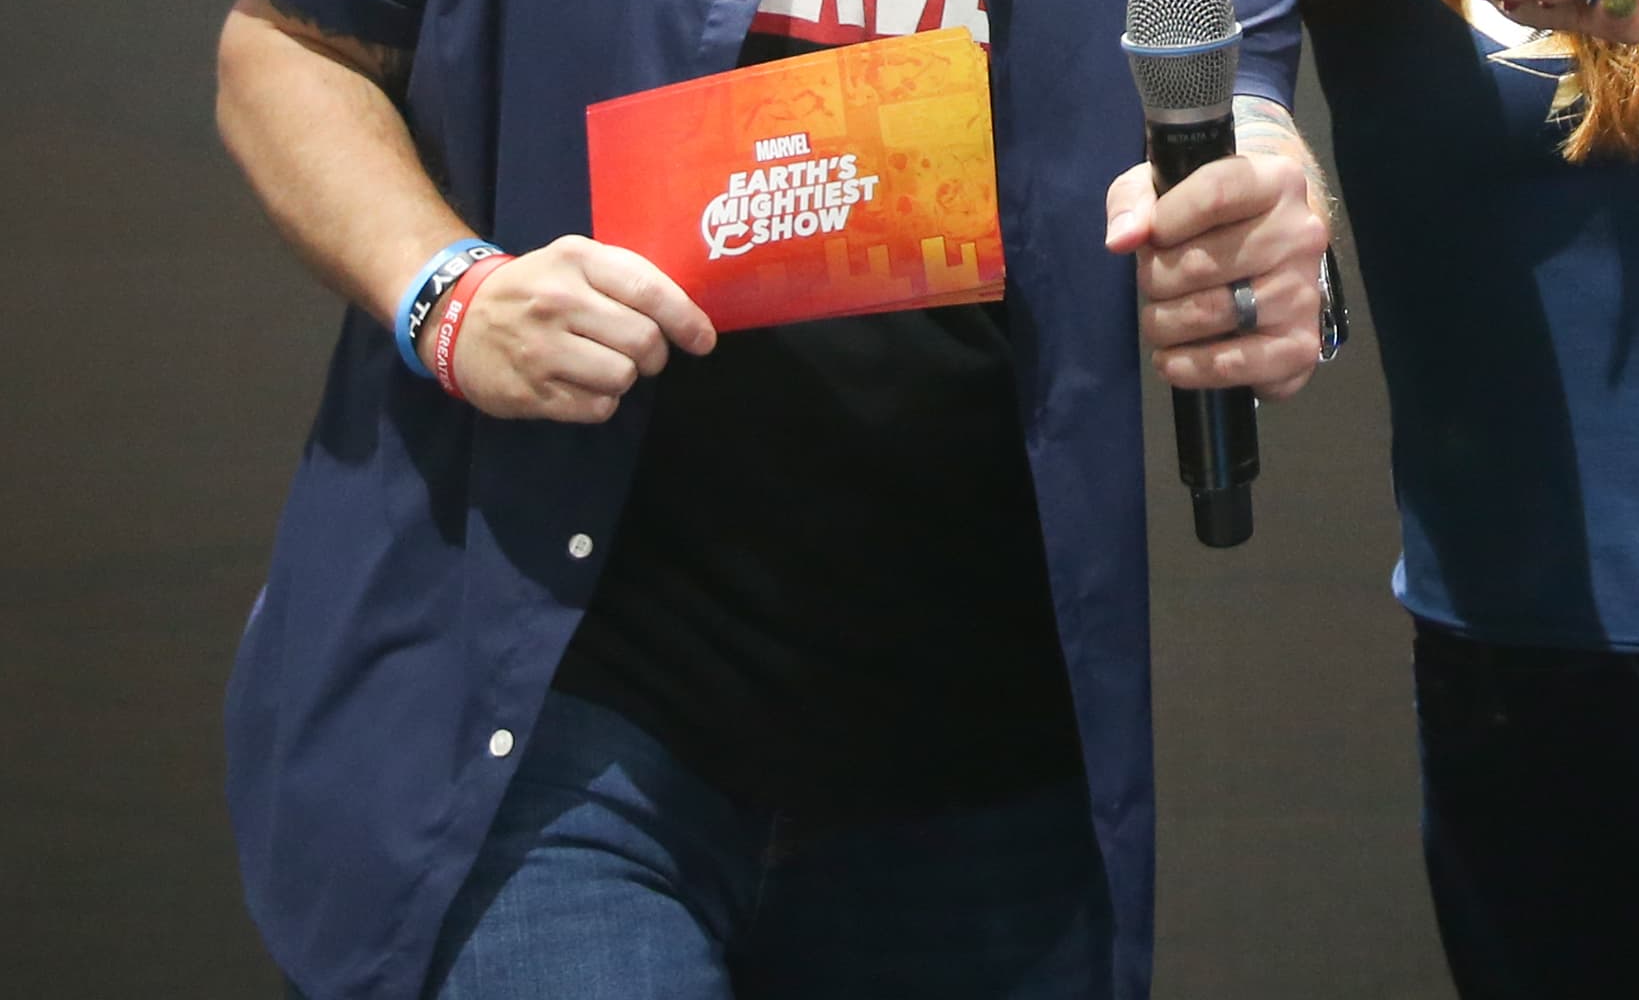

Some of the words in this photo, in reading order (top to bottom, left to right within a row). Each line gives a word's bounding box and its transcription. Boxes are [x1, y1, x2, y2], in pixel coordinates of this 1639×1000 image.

[755, 132, 811, 162] MARVEL
[728, 154, 857, 198] EARTH'S
[711, 175, 879, 226] MIGHTIEST
[751, 205, 850, 244] SHOW
[432, 256, 470, 296] BY
[444, 299, 463, 324] BE
